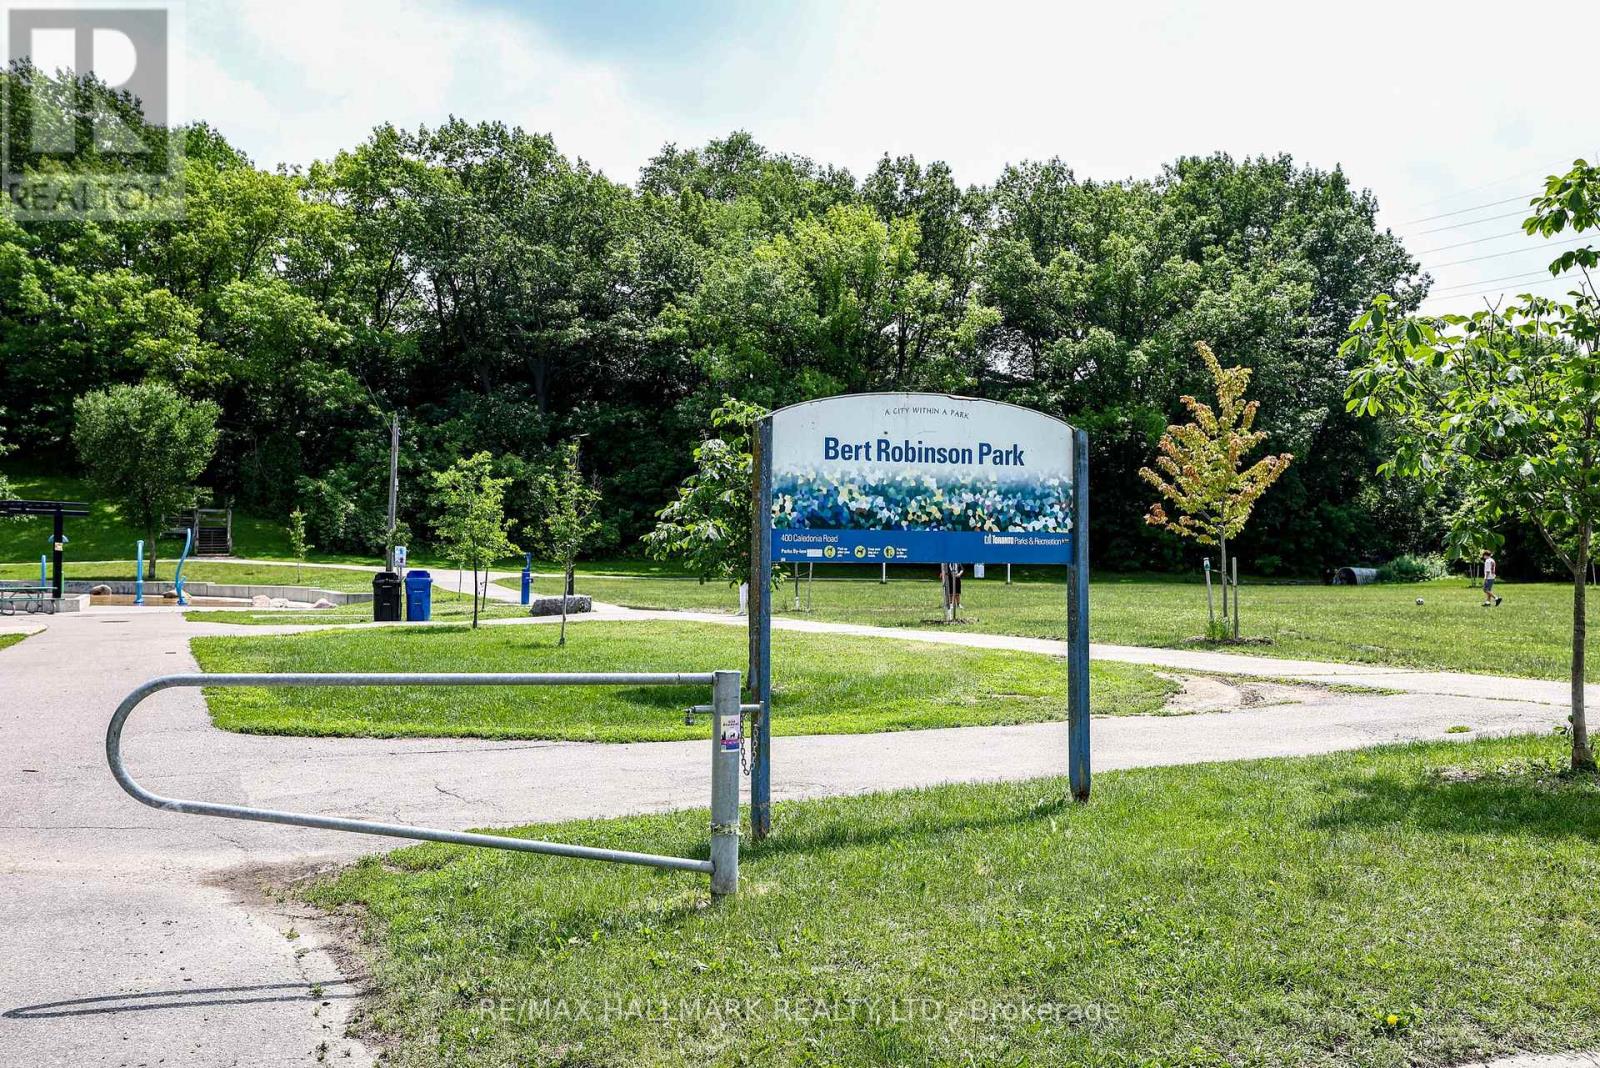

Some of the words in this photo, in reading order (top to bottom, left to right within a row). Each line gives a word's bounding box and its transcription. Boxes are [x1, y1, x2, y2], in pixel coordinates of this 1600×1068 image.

[893, 407, 909, 415] CITY
[951, 409, 969, 419] PARK
[824, 437, 871, 462] Bert
[876, 438, 972, 465] Robinson
[978, 442, 1025, 466] Park
[781, 534, 792, 542] 400
[793, 534, 822, 542] Caledonia
[1014, 537, 1029, 545] Parks
[1035, 537, 1062, 545] Recreation
